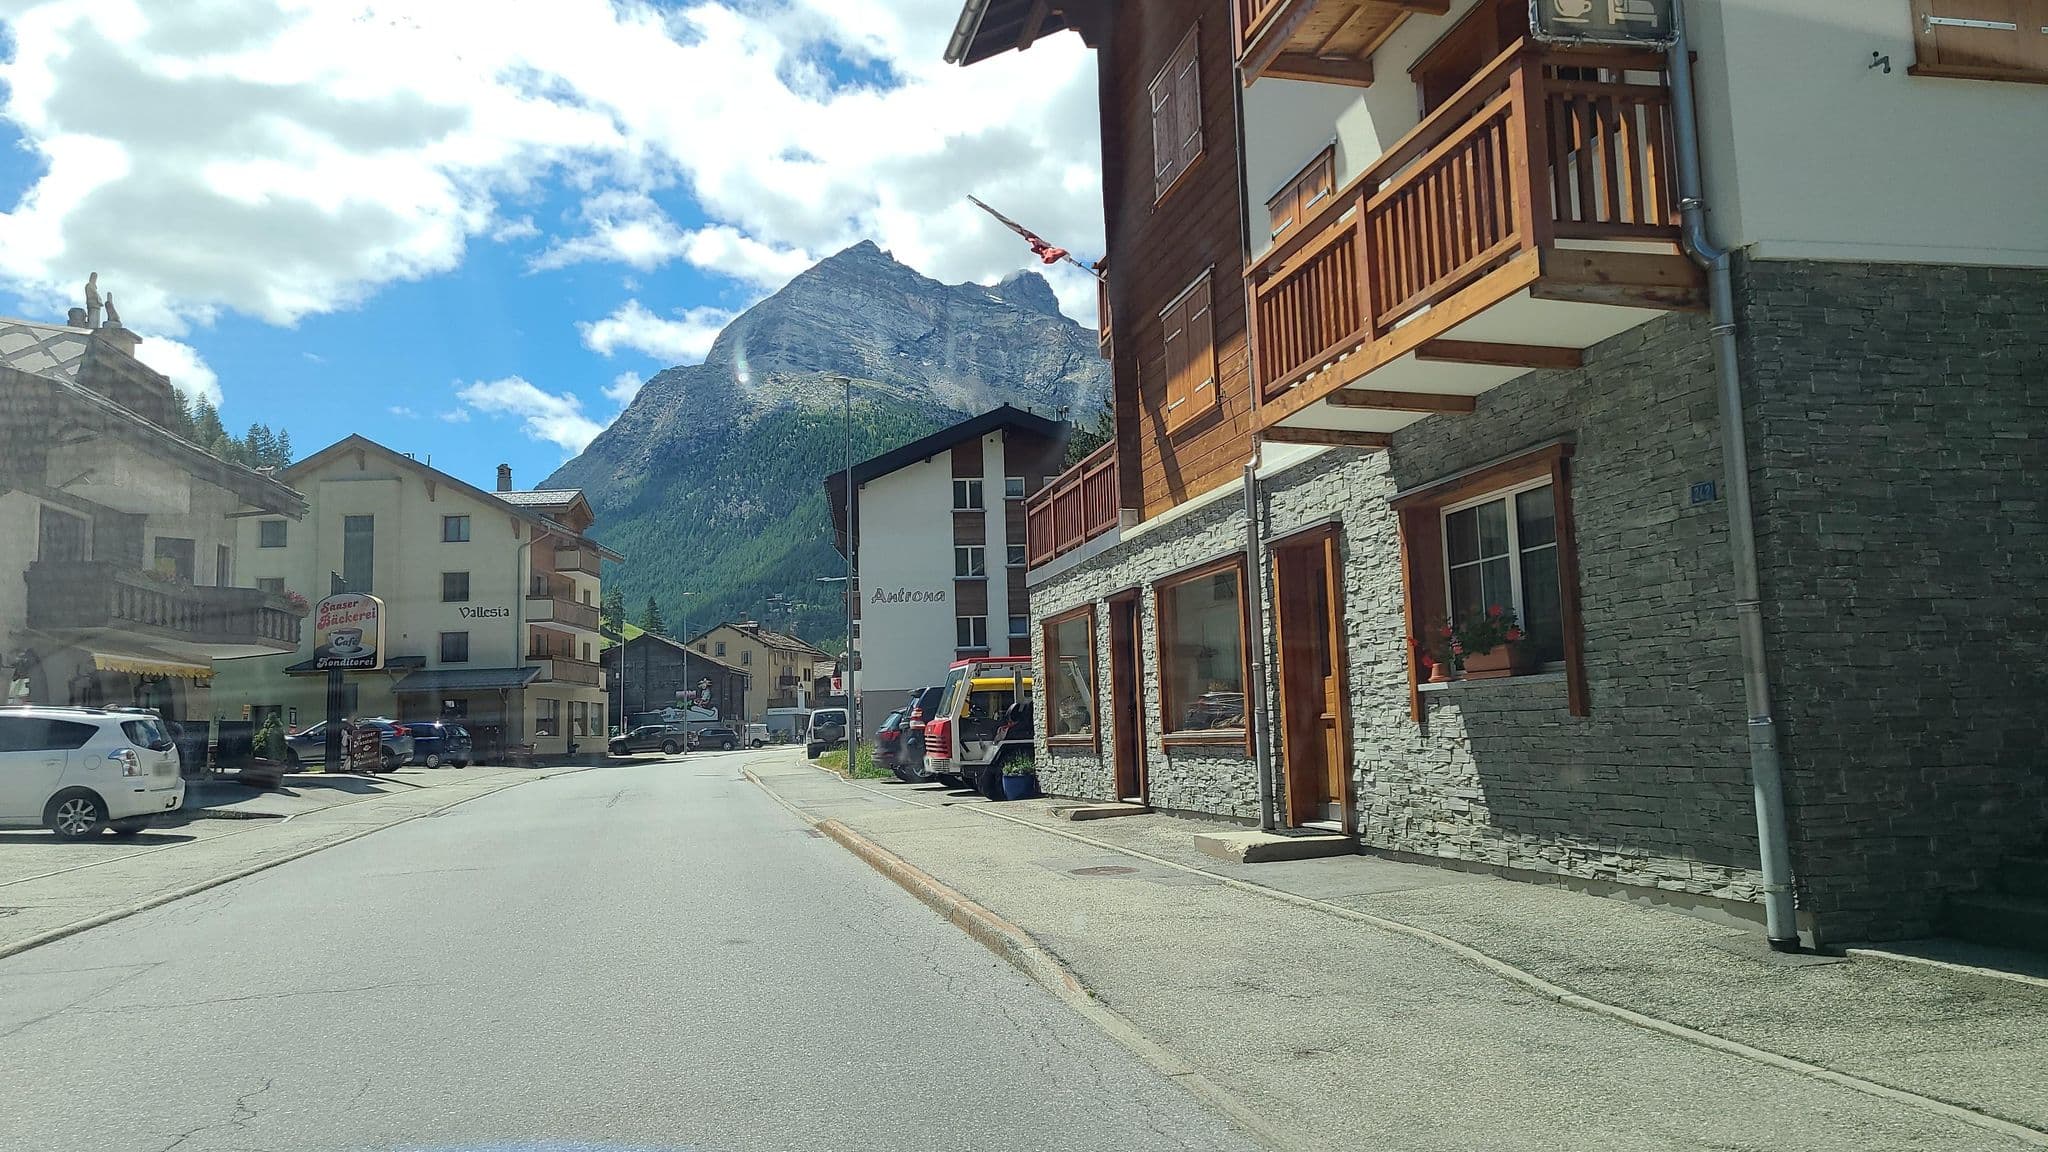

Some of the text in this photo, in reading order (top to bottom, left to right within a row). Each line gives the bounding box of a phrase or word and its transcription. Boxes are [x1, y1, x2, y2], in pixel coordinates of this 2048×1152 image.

[871, 587, 946, 604] Antrona
[320, 601, 359, 614] Saaser
[458, 606, 510, 619] Vallesia
[317, 607, 376, 630] Bäckerei
[316, 657, 374, 669] Konditorei
